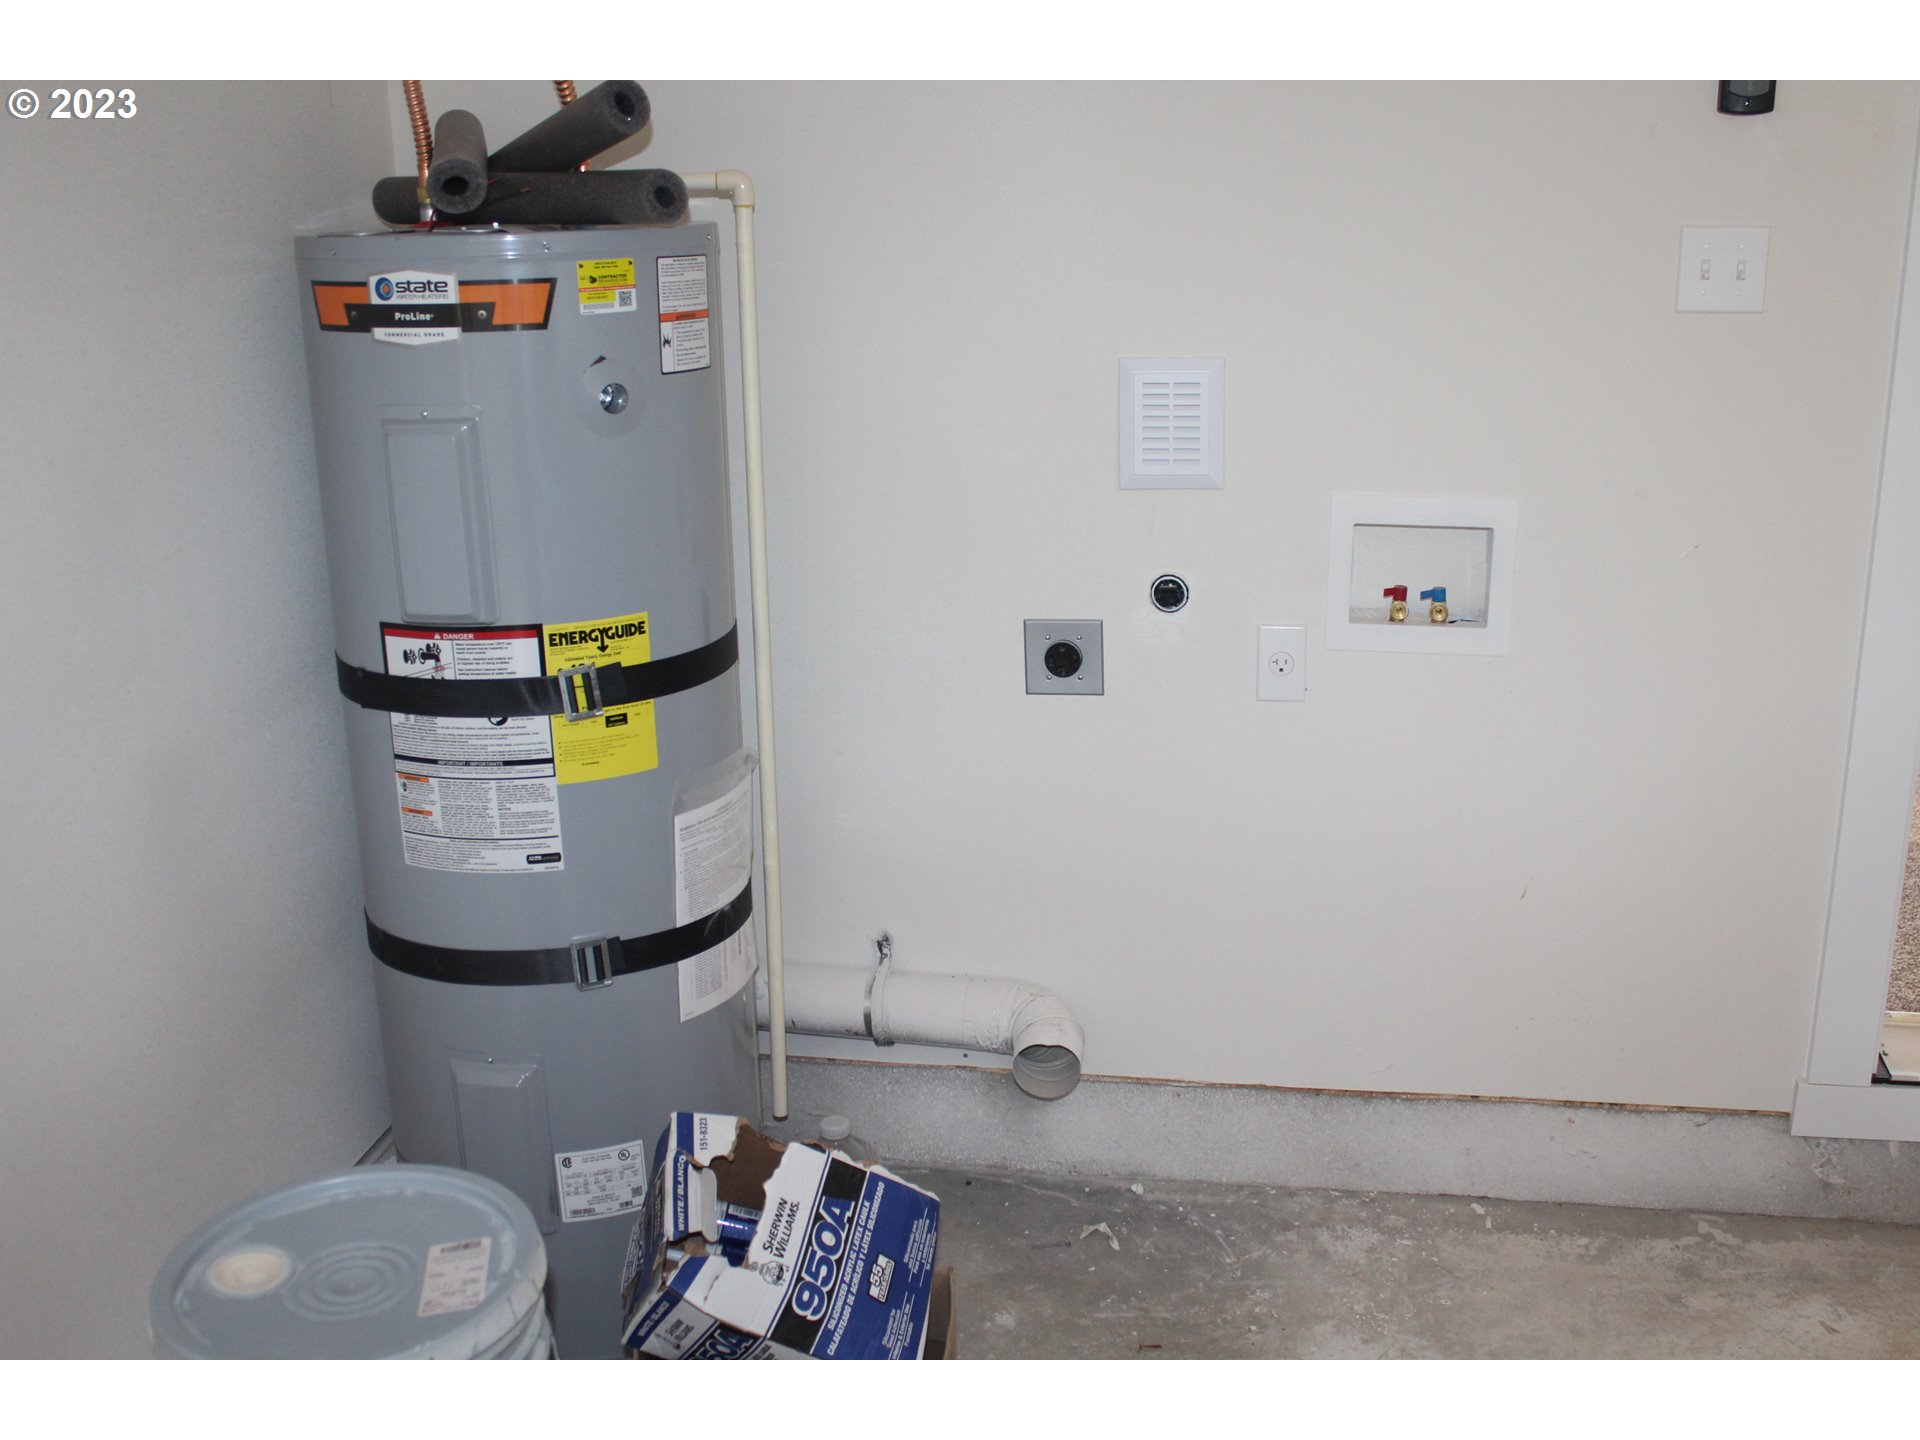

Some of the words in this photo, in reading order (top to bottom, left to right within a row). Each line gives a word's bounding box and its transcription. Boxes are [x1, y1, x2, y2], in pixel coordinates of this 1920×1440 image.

[395, 280, 448, 293] state
[548, 621, 646, 648] ENERGYGUIDE
[699, 1117, 708, 1151] 151-8323
[677, 1155, 687, 1231] WHITE/BLANCO
[763, 1197, 788, 1254] SHERWIN
[792, 1196, 856, 1321] 950A
[827, 1300, 852, 1356] CALAFATEADO
[847, 1294, 854, 1304] DE
[866, 1181, 884, 1229] SILICONIZADO
[828, 1284, 847, 1329] SILICONIZED
[843, 1251, 857, 1282] ACRYLIC
[852, 1227, 863, 1249] LATEX
[858, 1200, 869, 1224] CAULK
[869, 1264, 883, 1286] 55
